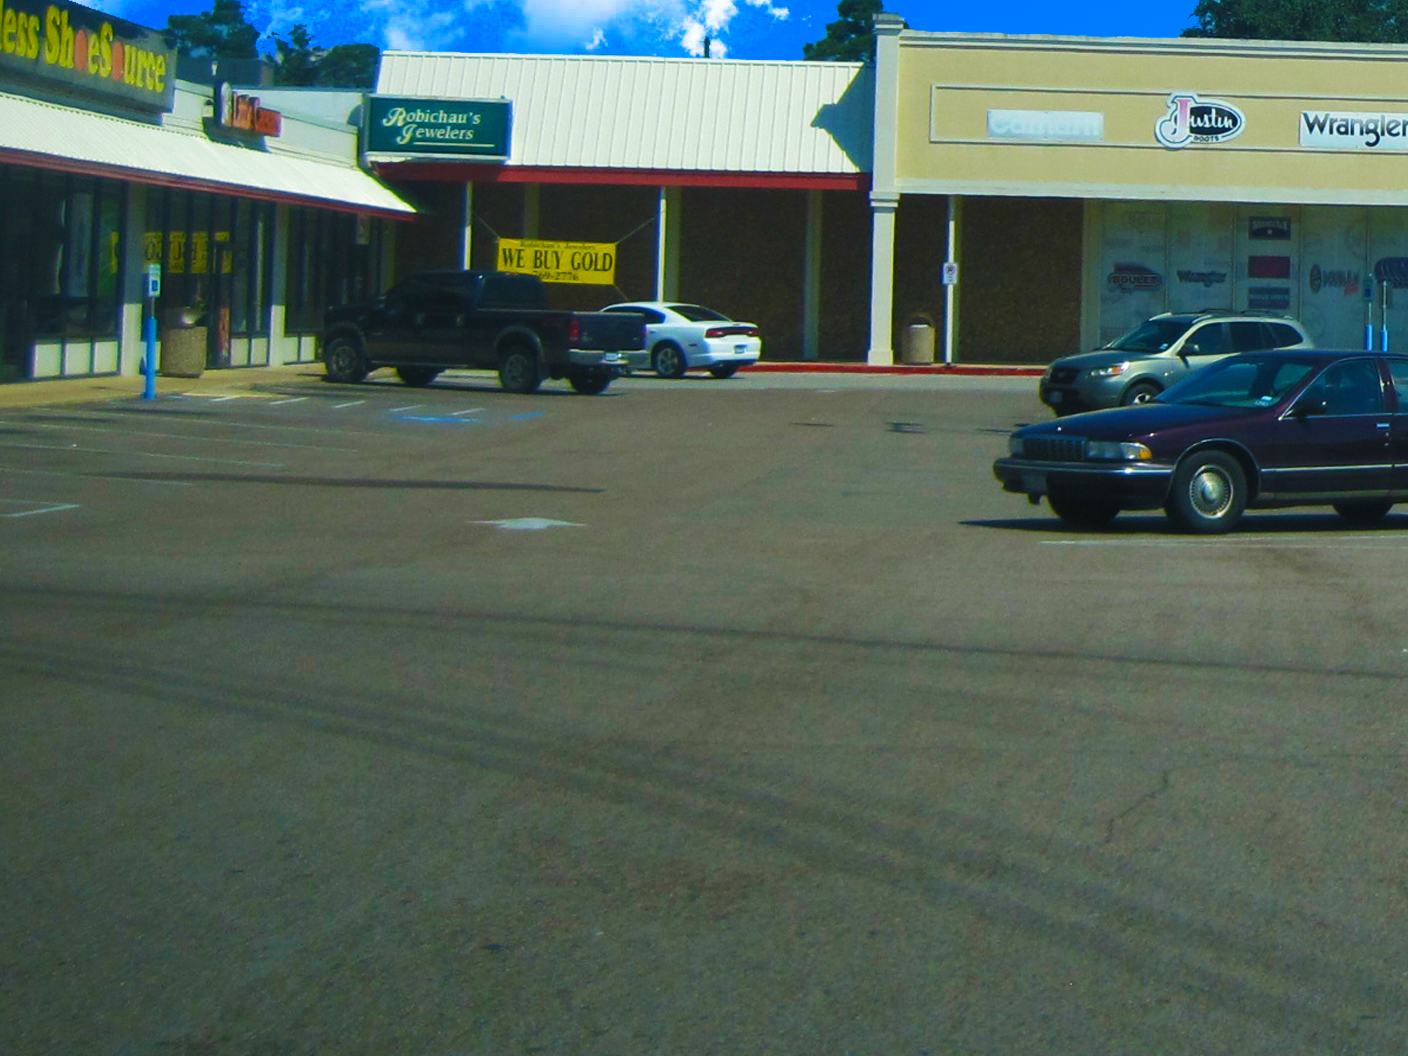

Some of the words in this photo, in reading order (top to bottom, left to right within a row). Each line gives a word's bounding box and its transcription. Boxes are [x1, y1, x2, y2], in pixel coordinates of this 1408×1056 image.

[382, 107, 481, 127] Robichau's
[1158, 96, 1236, 143] Justin
[396, 123, 474, 145] Jewelers
[502, 248, 525, 268] WE
[533, 249, 564, 270] BUY
[571, 250, 613, 272] GOLD
